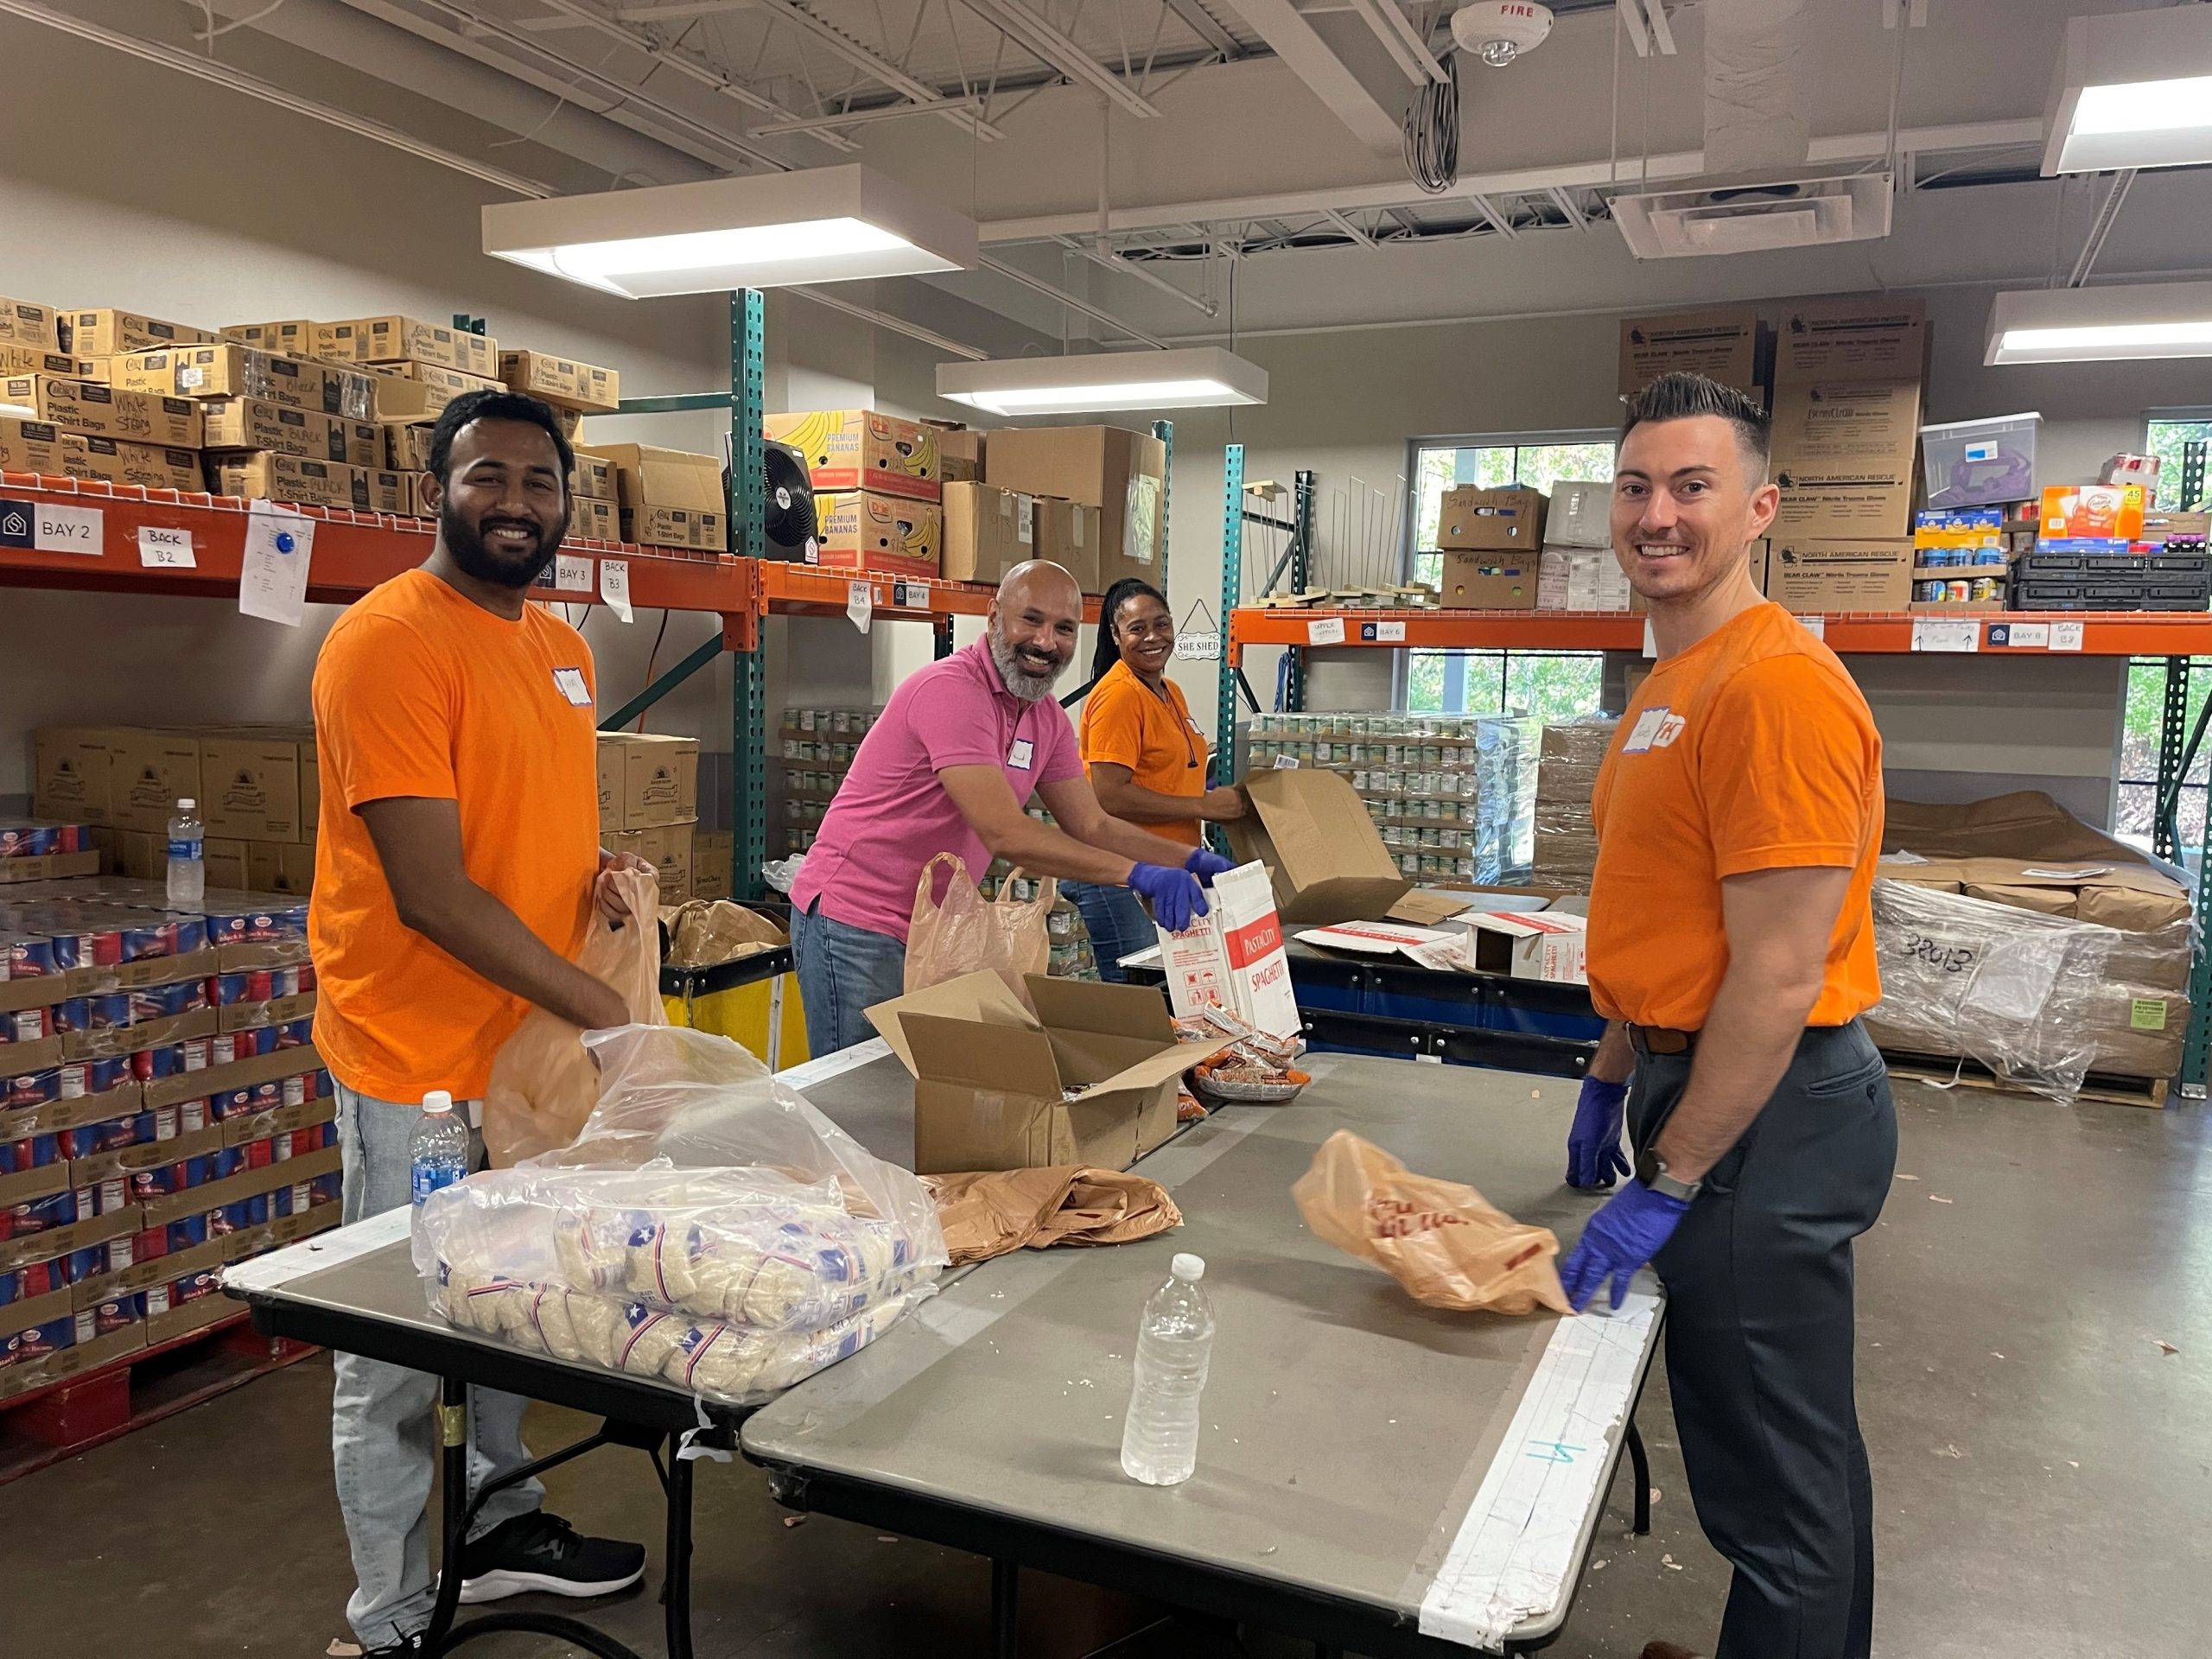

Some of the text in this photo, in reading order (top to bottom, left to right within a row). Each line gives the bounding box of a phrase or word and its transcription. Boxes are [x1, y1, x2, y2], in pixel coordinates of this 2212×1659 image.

[1500, 4, 1534, 17] FIRE
[125, 378, 147, 387] Plastic
[279, 391, 301, 406] Bags
[48, 403, 79, 414] Plastic
[48, 414, 106, 431] T-Shirt Bags
[873, 420, 889, 431] Dole
[254, 423, 283, 436] Plastic
[827, 433, 859, 442] PREMIUM
[255, 435, 308, 454] T-Shirt Bags
[827, 443, 859, 452] BANANAS
[63, 454, 87, 466] lastic
[276, 476, 306, 488] Plastic
[277, 489, 332, 504] T-Shirt Bags
[2127, 490, 2140, 499] 45
[872, 502, 889, 513] Dole
[824, 514, 857, 524] PREMIUM
[43, 521, 90, 539] BAY 2
[824, 524, 858, 535] BANANAS
[148, 530, 182, 545] BACK
[156, 550, 176, 563] B2
[1457, 551, 1506, 565] Sandwich
[605, 563, 626, 573] BACK
[560, 569, 586, 581] BAY 3
[609, 578, 620, 589] B3
[852, 583, 868, 593] BACK
[854, 596, 865, 605] B4
[1178, 642, 1218, 651] SHE SHED
[1172, 927, 1211, 940] SPAGHETTI
[1244, 927, 1275, 957] PASTACITY
[1251, 959, 1285, 993] SPAGHETTI
